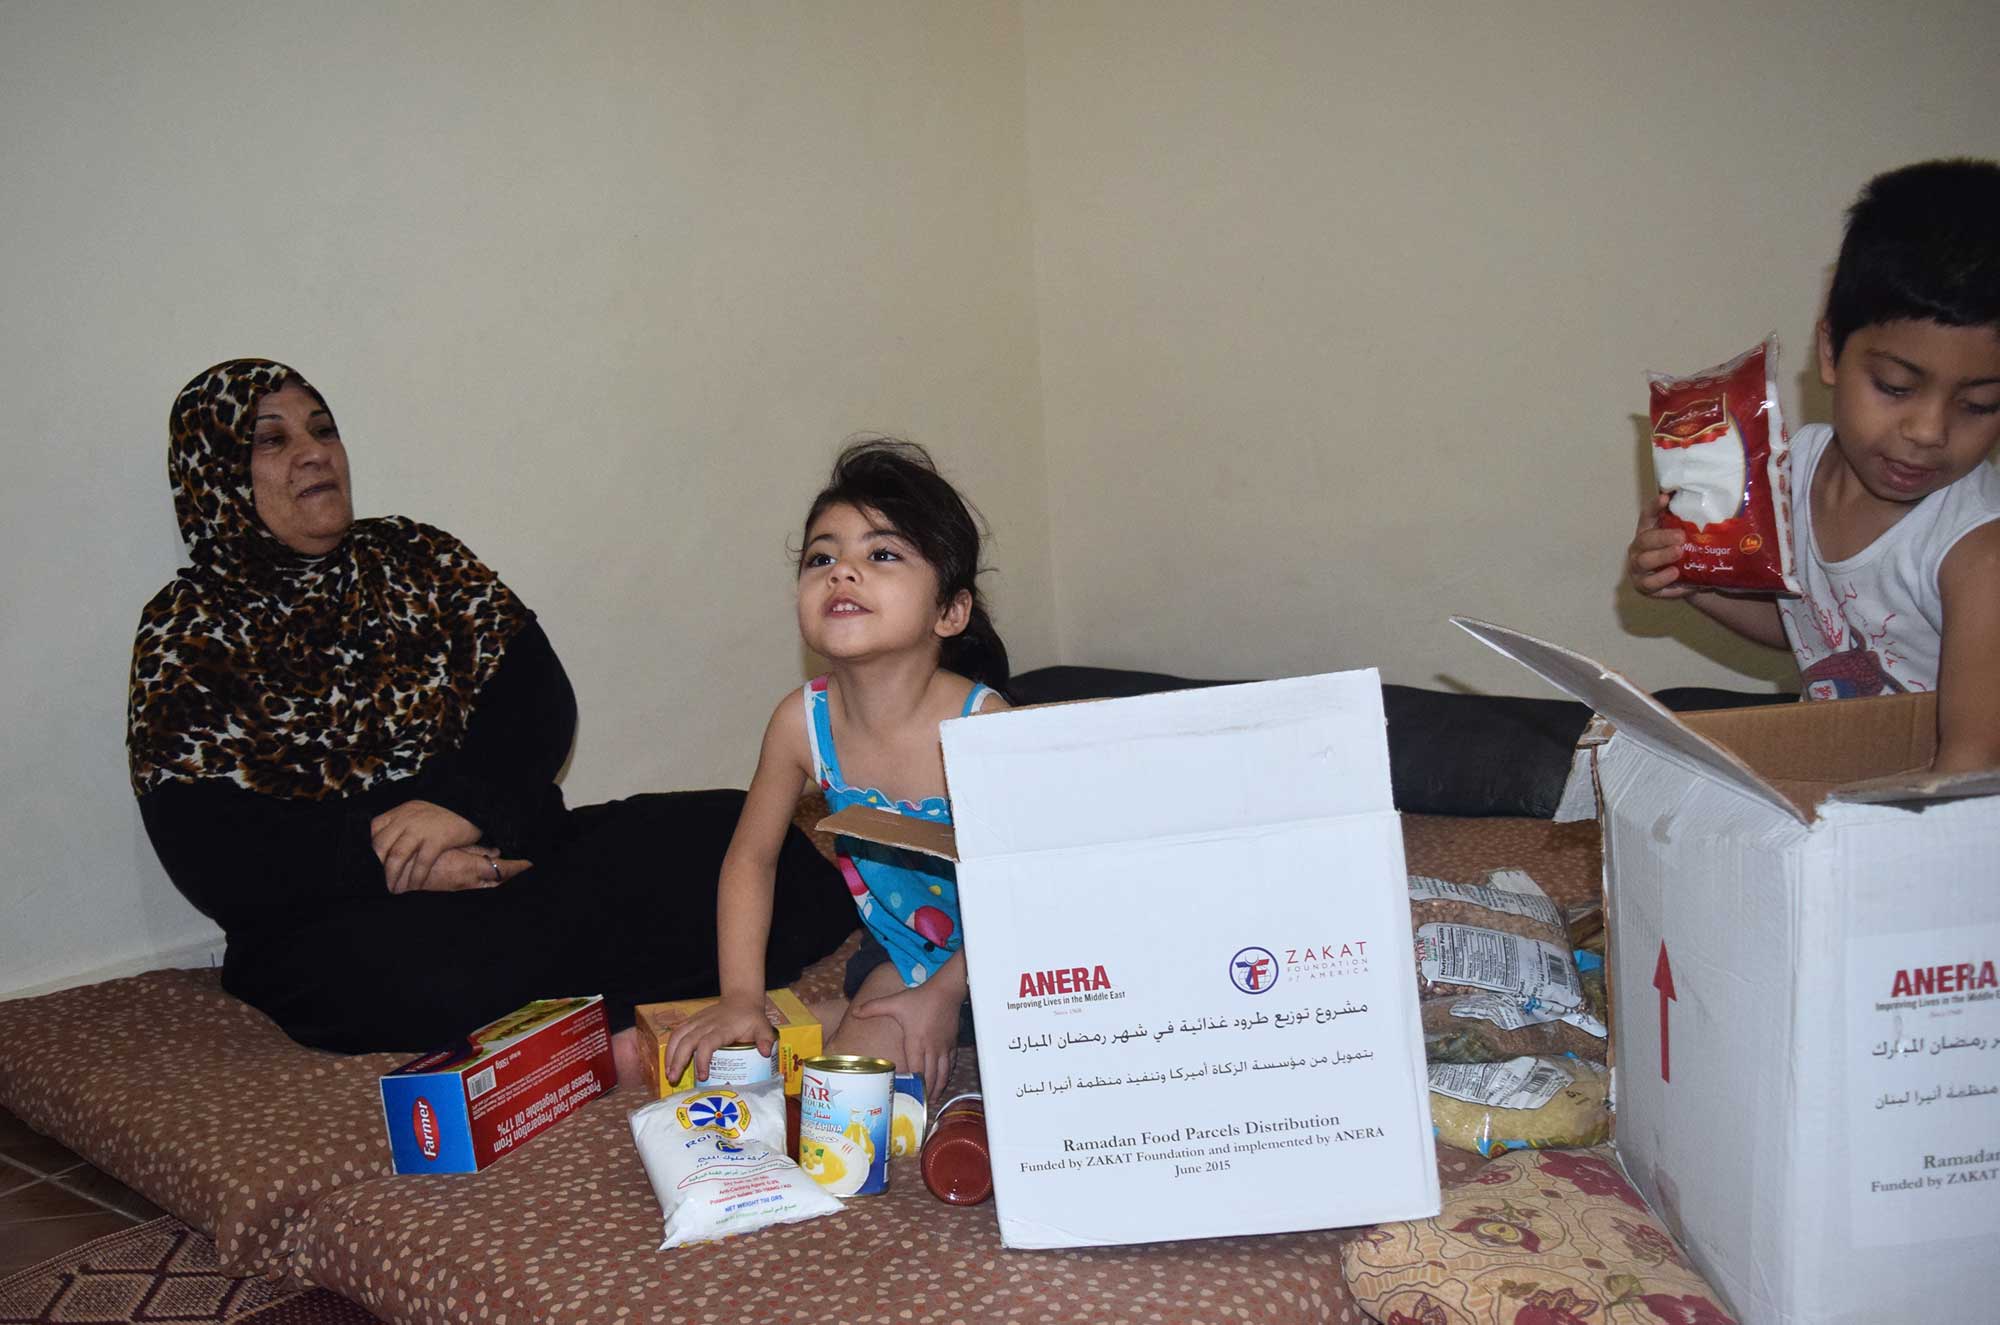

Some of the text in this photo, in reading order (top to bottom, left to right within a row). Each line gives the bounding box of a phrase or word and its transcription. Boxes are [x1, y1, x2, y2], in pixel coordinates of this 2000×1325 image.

[1704, 545, 1731, 556] Sugar
[1285, 941, 1367, 964] ZAKAT
[1287, 958, 1368, 973] FOUNDATION
[1310, 967, 1369, 979] AMERICA
[1019, 965, 1111, 998] ANERA
[1891, 961, 1998, 998] ANERA
[1007, 991, 1126, 1010] Improving Lives in the Middle East
[1008, 1000, 1368, 1053] مشروع توزيع طرود غذائية في شهر رمضان المبارك
[1930, 1036, 1987, 1055] رمضان
[571, 1070, 594, 1090] Cheese
[1016, 1049, 1374, 1097] بتمويل من مؤسسة الزكاة أميركا وتنفيذ منظمة أنيرا لبنان
[558, 1083, 570, 1101] and
[569, 1080, 602, 1108] Processed
[803, 1083, 830, 1102] TAR
[525, 1091, 558, 1118] Vegetable
[553, 1099, 570, 1119] Food
[418, 1101, 437, 1157] Farmer
[496, 1118, 513, 1137] 17%
[513, 1109, 553, 1140] Preparation
[515, 1111, 525, 1127] Oil
[494, 1134, 513, 1152] From
[1063, 1114, 1340, 1152] Ramadan Food Parcels Distribution
[1020, 1127, 1385, 1173] Funded by ZAKAT Foundation and implemented by ANERA
[1174, 1159, 1231, 1178] June 2015
[1871, 1168, 1999, 1192] Funded by ZAKAT
[725, 1204, 736, 1212] NET
[737, 1199, 759, 1209] WEIGHT
